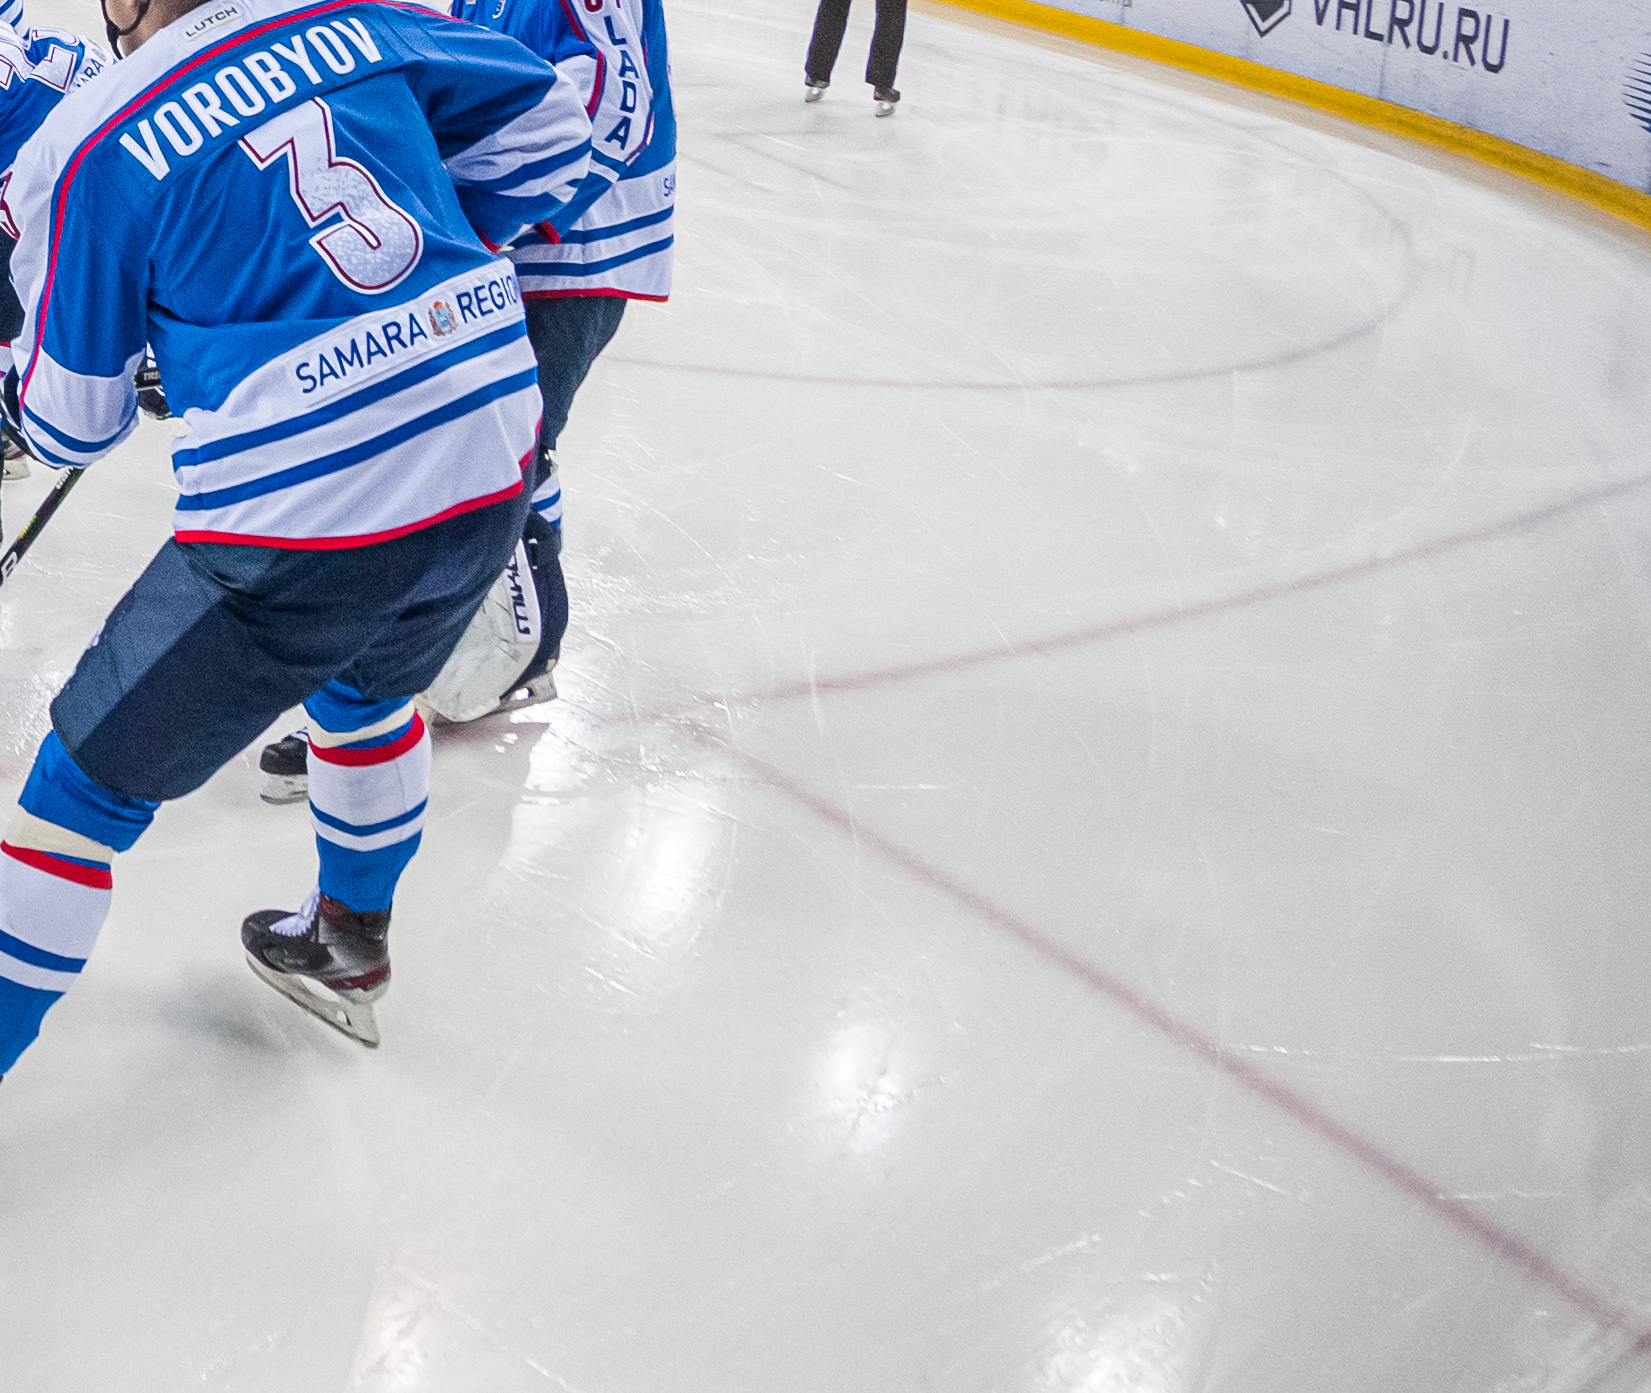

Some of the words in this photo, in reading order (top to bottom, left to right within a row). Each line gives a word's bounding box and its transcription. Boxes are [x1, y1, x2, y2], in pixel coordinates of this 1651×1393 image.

[184, 5, 239, 38] LUTCH
[603, 14, 641, 151] LADA
[118, 17, 384, 182] VOROBYOV
[238, 96, 424, 295] 3
[295, 312, 429, 395] SAMARA
[455, 274, 519, 325] REGIO
